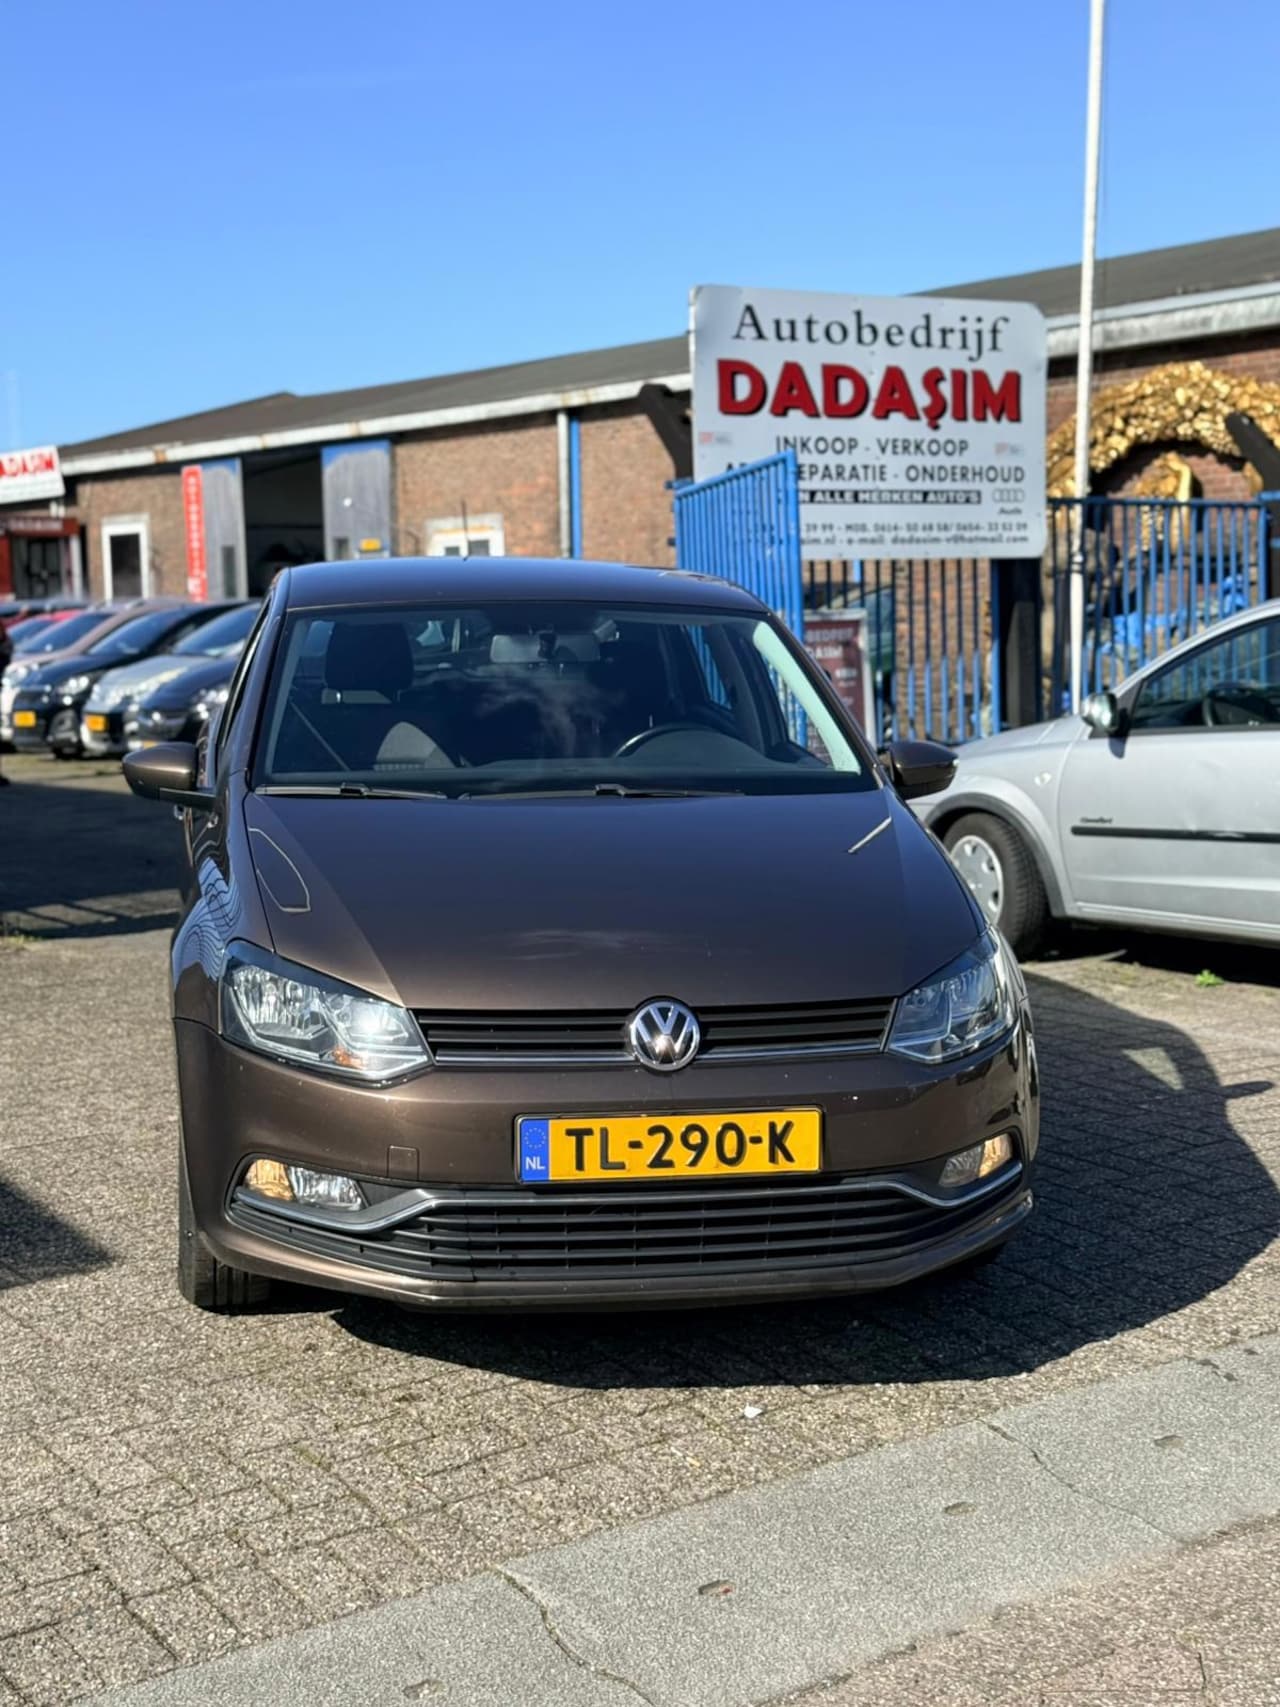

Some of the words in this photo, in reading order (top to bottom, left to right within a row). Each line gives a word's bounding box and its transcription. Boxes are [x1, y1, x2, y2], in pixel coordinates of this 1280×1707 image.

[732, 303, 1010, 362] Autobedrijf
[716, 358, 1022, 431] DADAŞIM
[776, 435, 859, 455] INKOOP
[877, 437, 969, 456] VERKOOP
[798, 463, 887, 482] EPARATIE
[905, 464, 1025, 483] ONDERHOUD
[813, 490, 855, 503] ALLE
[857, 490, 923, 503] MERKEN
[926, 490, 979, 503] AUTO'S
[565, 1121, 796, 1172] TL-290-K
[525, 1156, 546, 1170] NL
